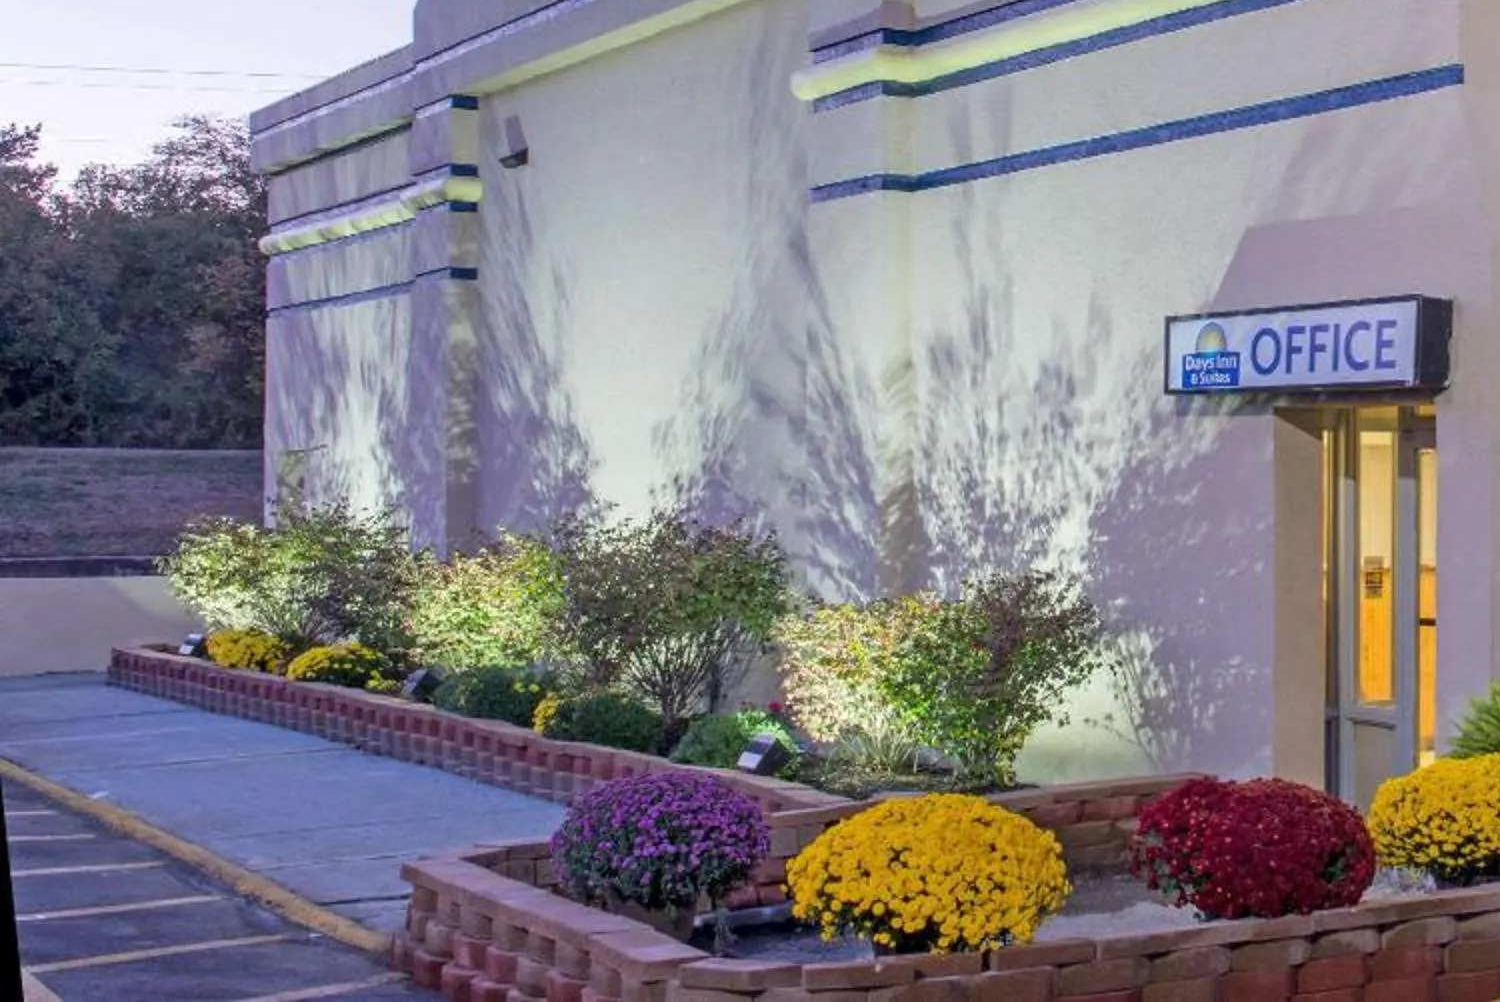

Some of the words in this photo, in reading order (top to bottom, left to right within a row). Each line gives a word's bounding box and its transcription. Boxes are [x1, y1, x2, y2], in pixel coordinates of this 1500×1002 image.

[1185, 355, 1215, 370] Days
[1216, 353, 1237, 368] Inn
[1251, 319, 1398, 376] OFFICE
